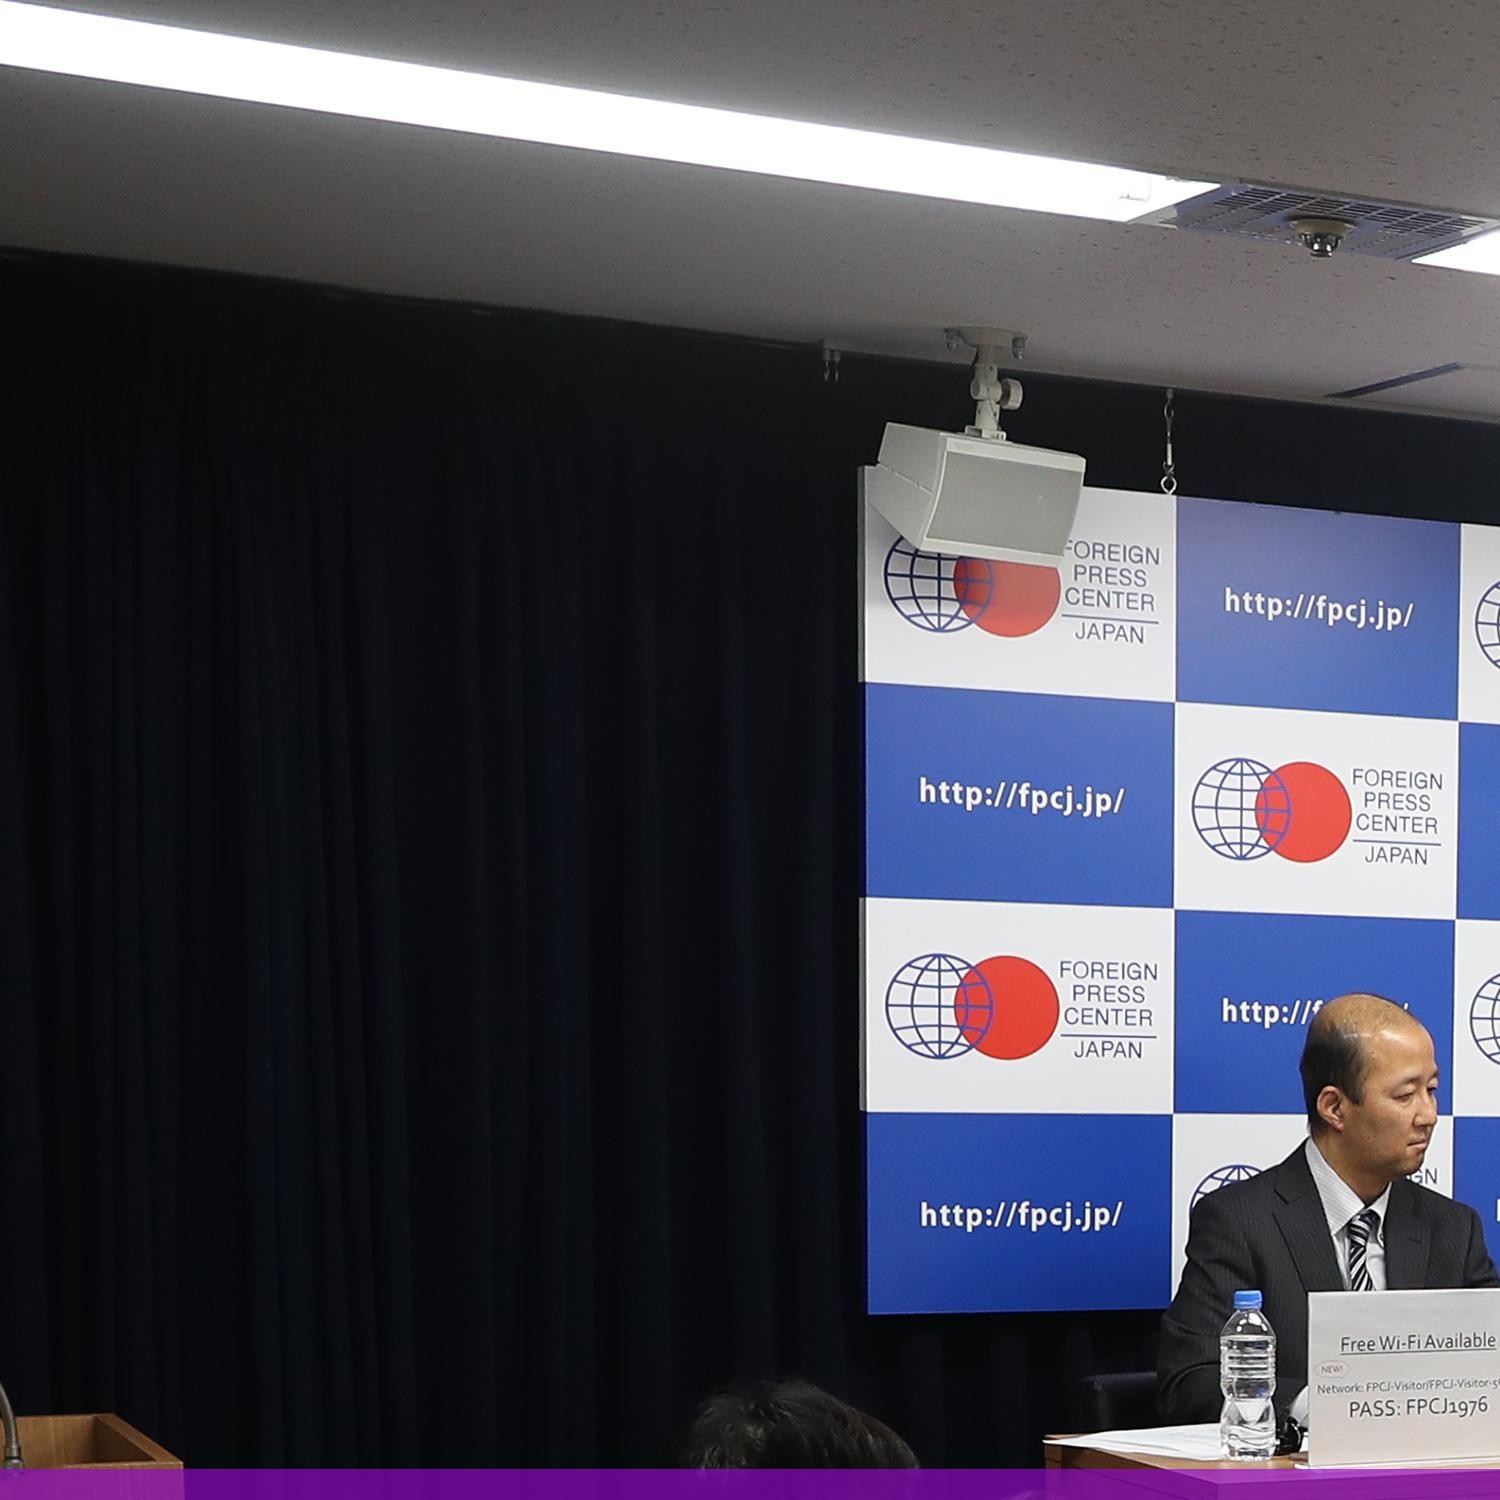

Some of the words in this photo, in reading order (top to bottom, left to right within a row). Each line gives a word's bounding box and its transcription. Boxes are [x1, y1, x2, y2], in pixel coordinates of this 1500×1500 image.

[1073, 563, 1147, 588] PRESS
[1064, 586, 1155, 612] CENTER
[1225, 587, 1414, 631] http://fpcj.jp/
[1074, 621, 1144, 644] JAPAN
[1352, 768, 1443, 790] FOREIGN
[920, 777, 1125, 818] http://fpcj.jp/
[1364, 791, 1431, 812] PRESS
[1355, 813, 1438, 835] CENTER
[1364, 846, 1428, 865] JAPAN
[1060, 960, 1158, 981] FOREIGN
[1072, 984, 1145, 1004] PRESS
[1064, 1007, 1153, 1027] CENTER
[1074, 1040, 1142, 1059] JAPAN
[921, 1200, 1123, 1233] http://fpcj.jp/
[1341, 1336, 1376, 1352] Free
[1378, 1334, 1421, 1351] Wi-Fi
[1424, 1331, 1496, 1349] Available
[1317, 1382, 1364, 1395] Network:
[1349, 1399, 1401, 1418] PASS:
[1406, 1395, 1488, 1418] FPCJ1976
